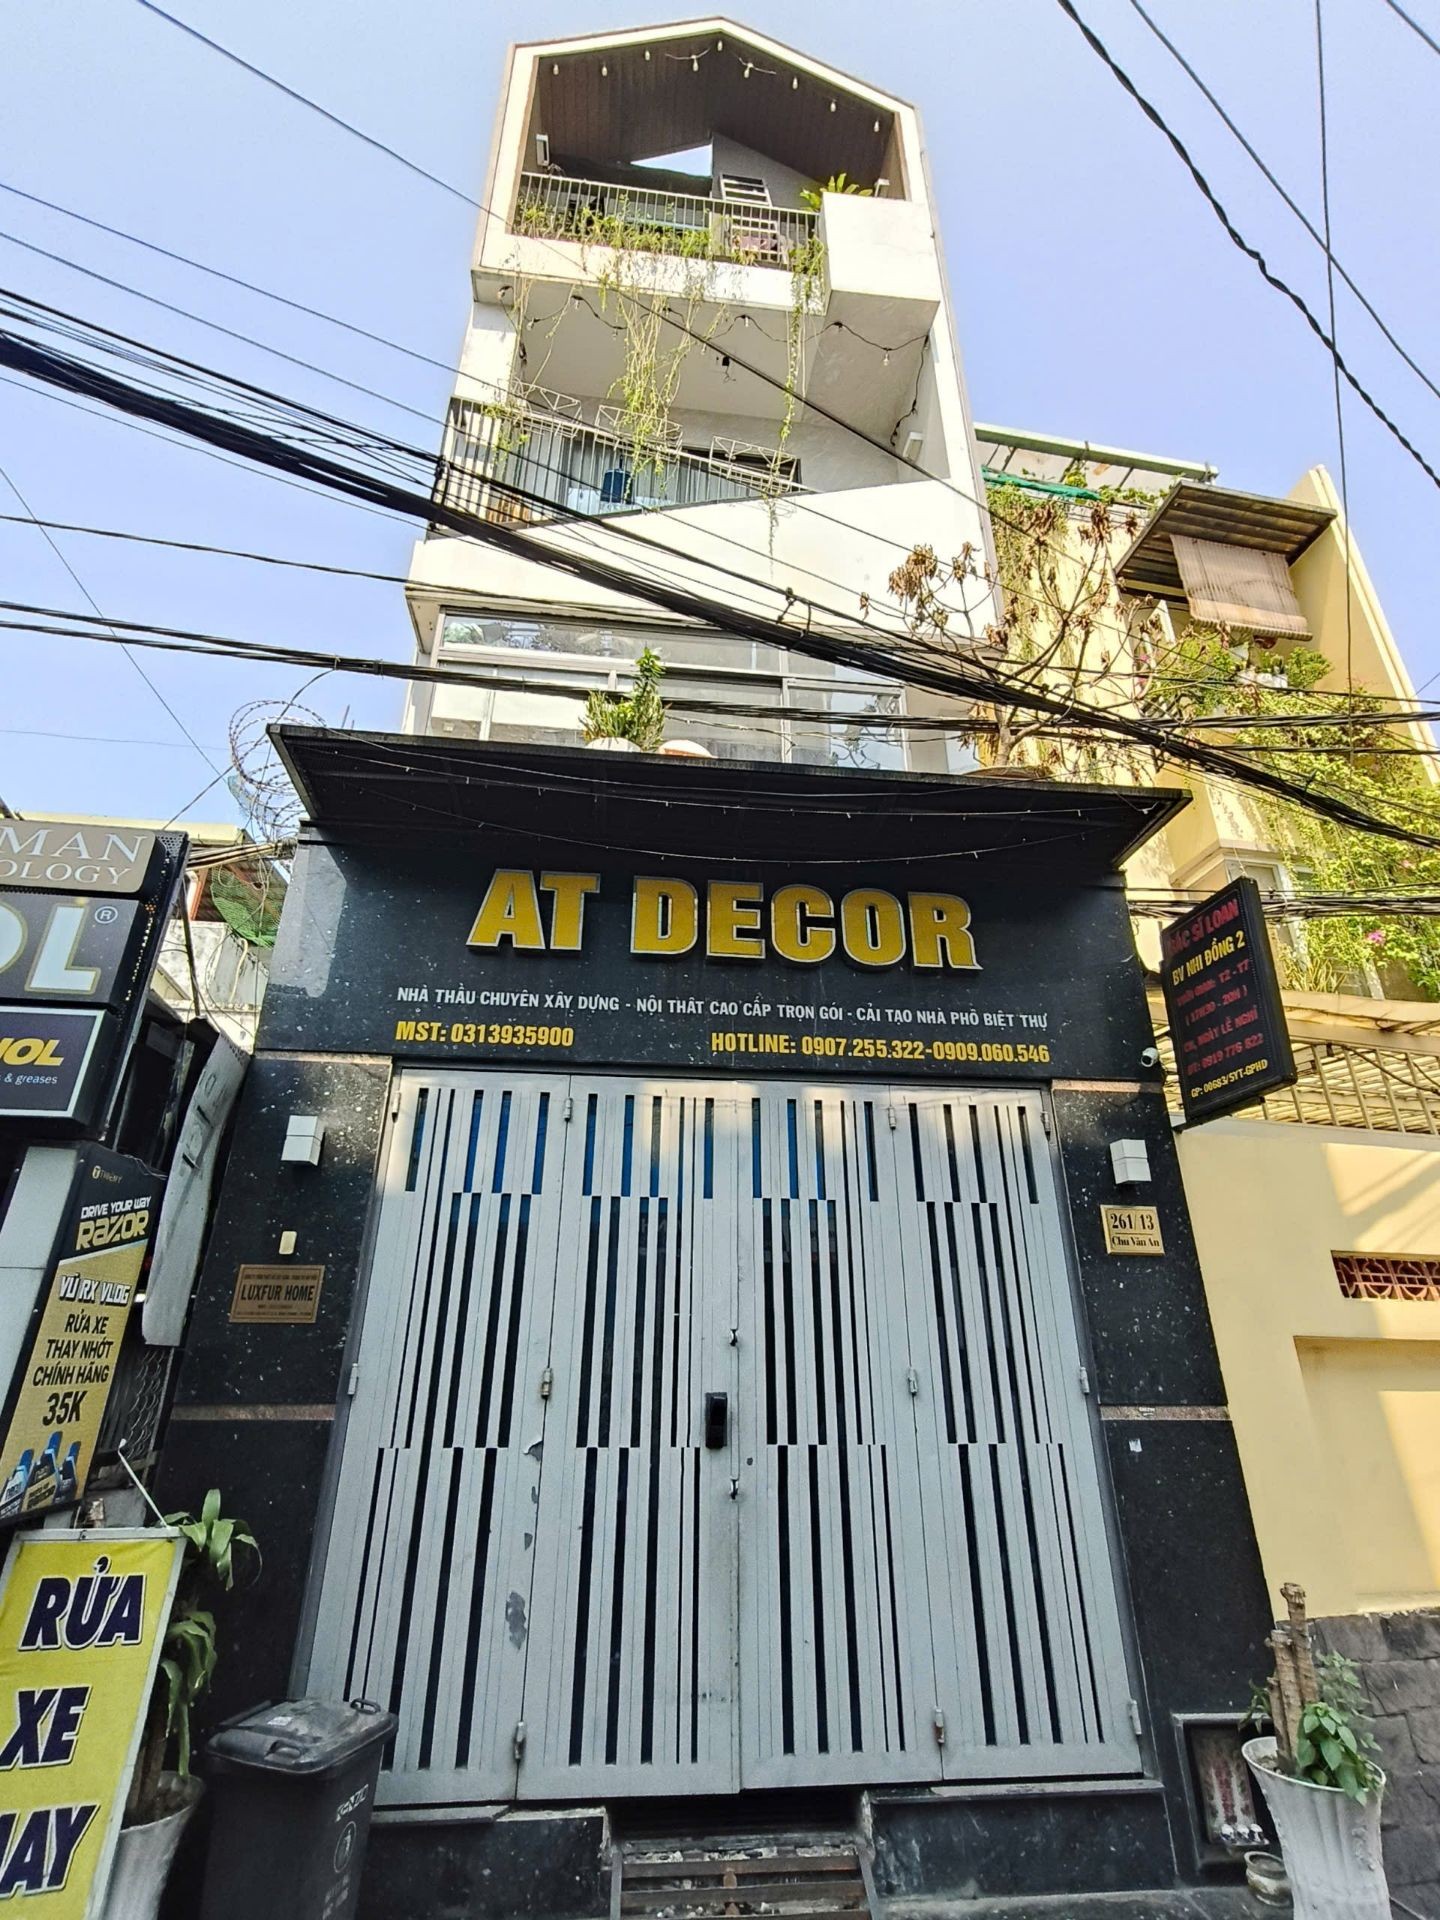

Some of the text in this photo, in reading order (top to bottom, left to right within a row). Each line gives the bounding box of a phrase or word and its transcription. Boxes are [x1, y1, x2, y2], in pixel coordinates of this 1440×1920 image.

[466, 868, 983, 971] AT DECOR
[1206, 899, 1239, 933] LOAN
[1172, 930, 1245, 986] BV NHI ĐỒNG 2
[397, 984, 428, 1002] NHÀ
[435, 983, 476, 1005] THẦU
[480, 988, 539, 1008] CHUYÊN
[544, 991, 573, 1009] XÂY
[578, 994, 620, 1013] DỰNG
[636, 994, 662, 1016] NỘI
[709, 1000, 738, 1016] CAO
[743, 993, 771, 1017] CẤP
[777, 1004, 815, 1022] TRỌN
[819, 1002, 843, 1020] GÓI
[856, 1002, 880, 1022] CẢI
[885, 1009, 912, 1026] TẠO
[917, 1008, 946, 1024] NHÀ
[983, 1010, 1014, 1031] BIỆT
[1020, 1008, 1047, 1032] THỰ
[395, 1021, 574, 1047] MST: 0313935900
[711, 1033, 796, 1054] HOTLINE:
[15, 1074, 58, 1086] greases
[1191, 1087, 1203, 1098] GP:
[80, 1203, 109, 1219] DRIVE
[110, 1200, 133, 1213] YOUR
[1110, 1213, 1154, 1230] 261/13
[1112, 1236, 1129, 1246] Chu
[79, 1279, 100, 1303] RX
[100, 1281, 131, 1306] VLOG
[241, 1284, 315, 1301] LUXFUR HOME
[64, 1308, 109, 1334] RỬA XE
[46, 1336, 113, 1359] THAY NHỚT
[33, 1361, 109, 1386] CHÍNH HÃNG
[43, 1391, 87, 1426] 35K
[18, 1554, 146, 1651] RỬA
[0, 1685, 93, 1771] XE
